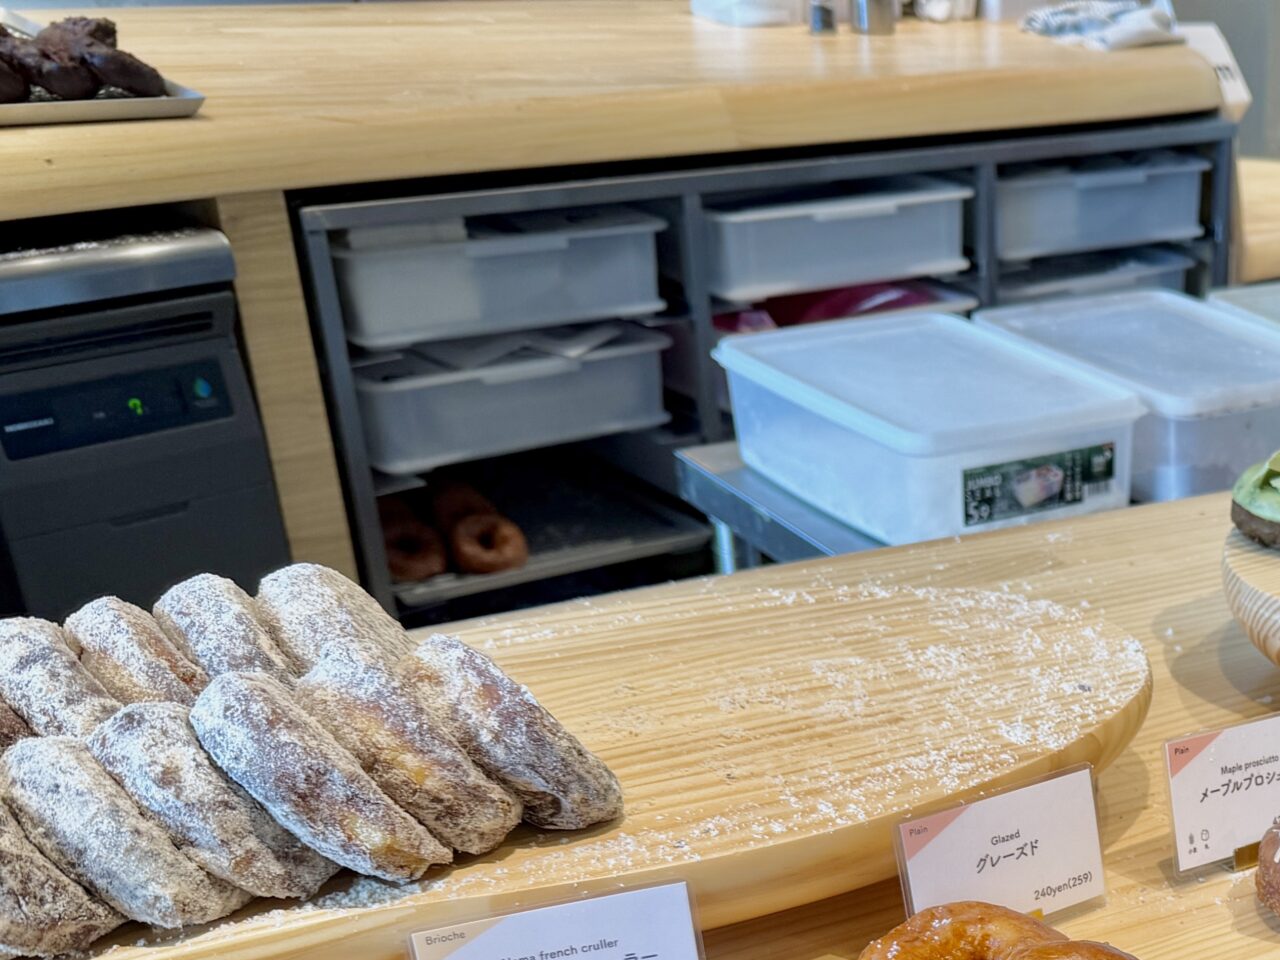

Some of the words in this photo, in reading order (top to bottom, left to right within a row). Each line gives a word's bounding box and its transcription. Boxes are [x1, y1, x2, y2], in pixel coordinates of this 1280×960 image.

[1220, 762, 1243, 777] Maple
[1245, 755, 1279, 773] prosciutto
[909, 825, 929, 837] Plain
[991, 829, 1021, 847] Glazed
[976, 839, 1039, 875] グレーズド
[1034, 870, 1093, 901] 240yen(259)
[425, 930, 466, 946] Brioche
[580, 938, 619, 955] cruller
